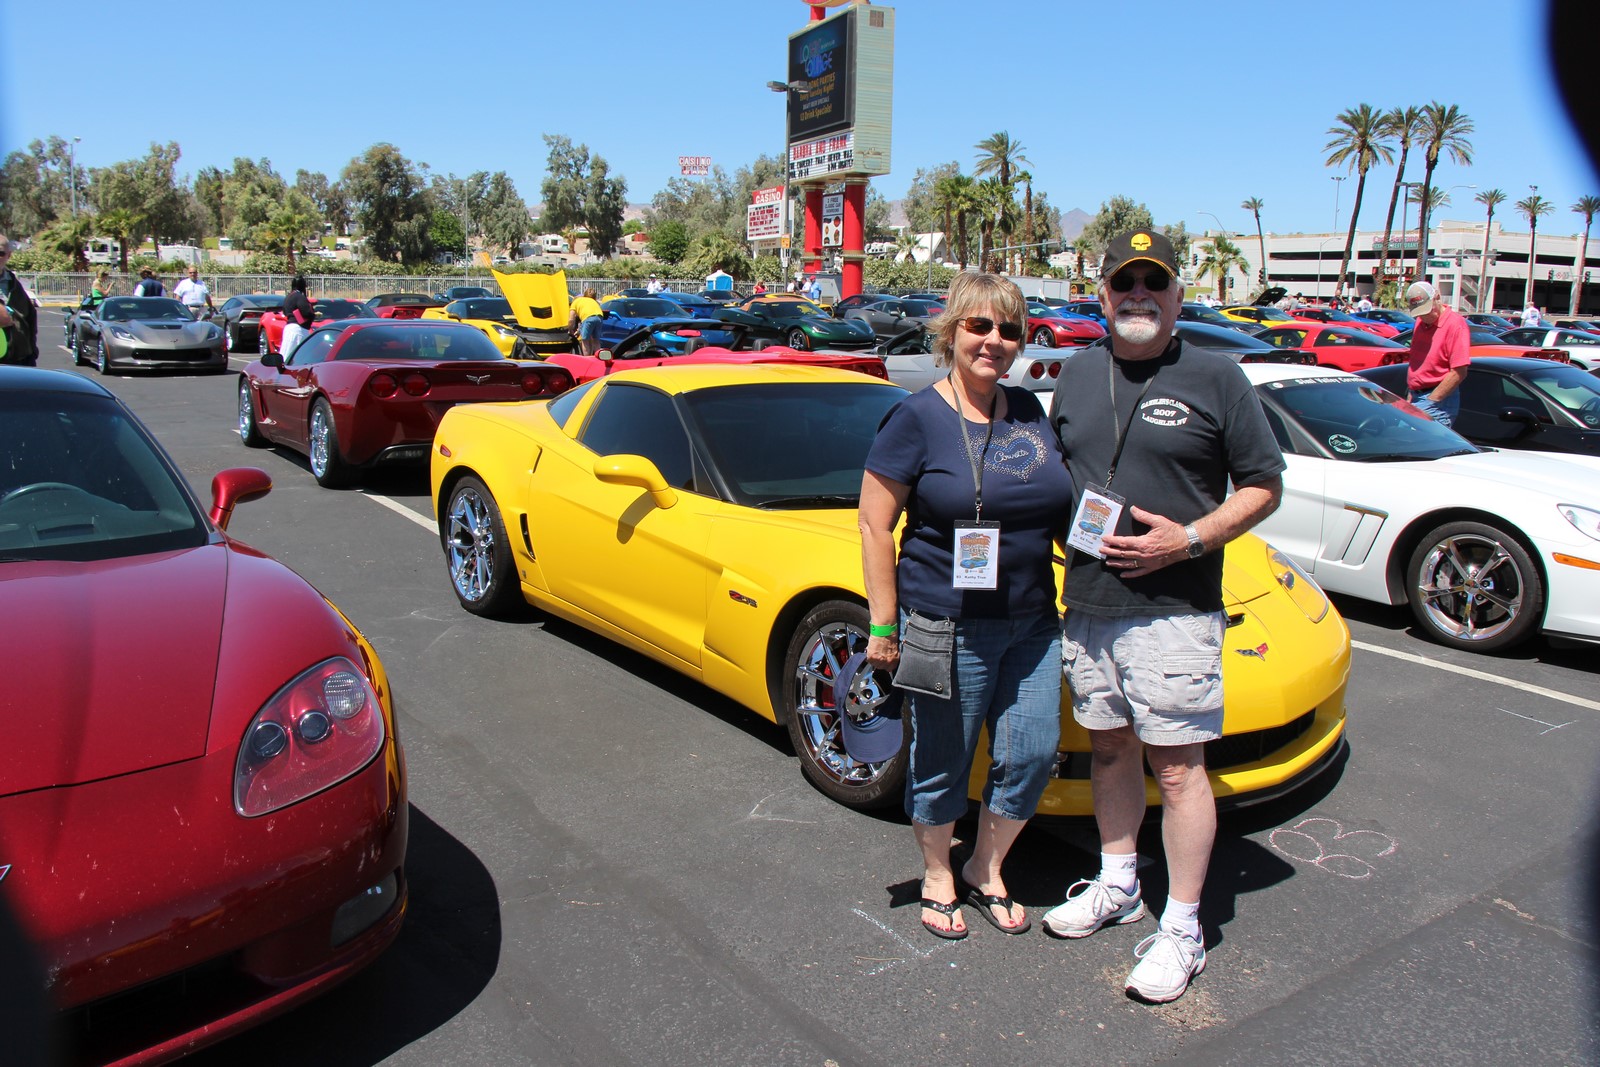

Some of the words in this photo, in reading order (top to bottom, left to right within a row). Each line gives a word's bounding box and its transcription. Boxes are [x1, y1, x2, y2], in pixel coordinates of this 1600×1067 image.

[816, 139, 826, 154] AND
[829, 134, 847, 152] FRANK
[679, 157, 711, 166] CASINO
[815, 155, 825, 165] THAT
[828, 151, 840, 162] NEVER
[755, 191, 781, 204] CASINO
[1153, 408, 1177, 417] 2007
